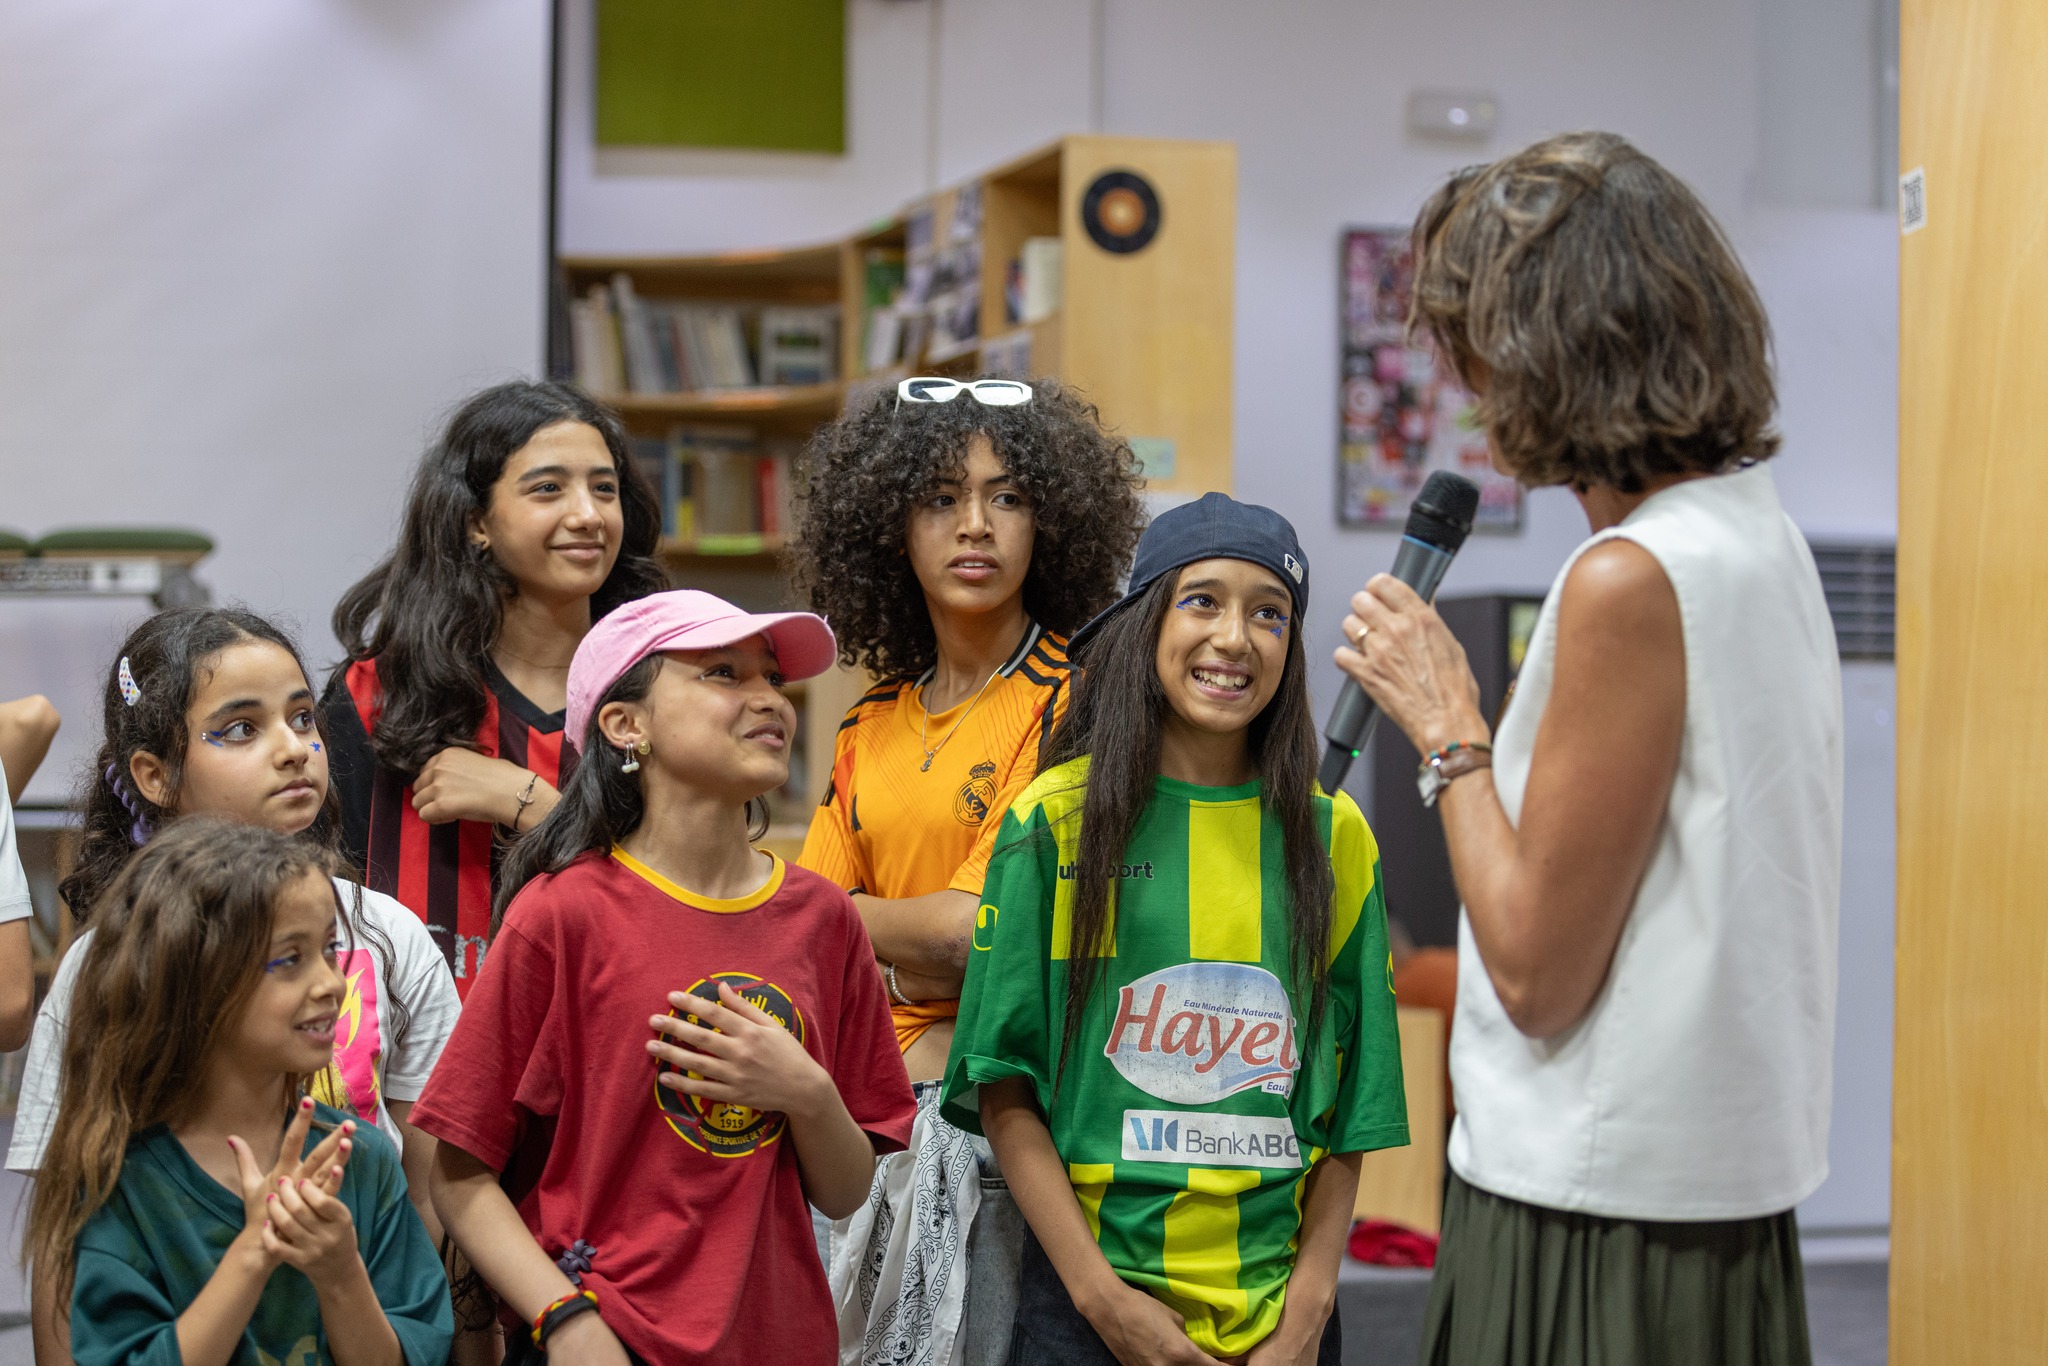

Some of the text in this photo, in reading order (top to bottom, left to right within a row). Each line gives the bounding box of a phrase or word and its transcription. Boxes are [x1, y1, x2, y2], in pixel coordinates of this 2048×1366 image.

[1184, 999, 1284, 1021] Eau Minérale Naturelle
[1266, 1081, 1285, 1092] Eau
[720, 1118, 744, 1129] 1919
